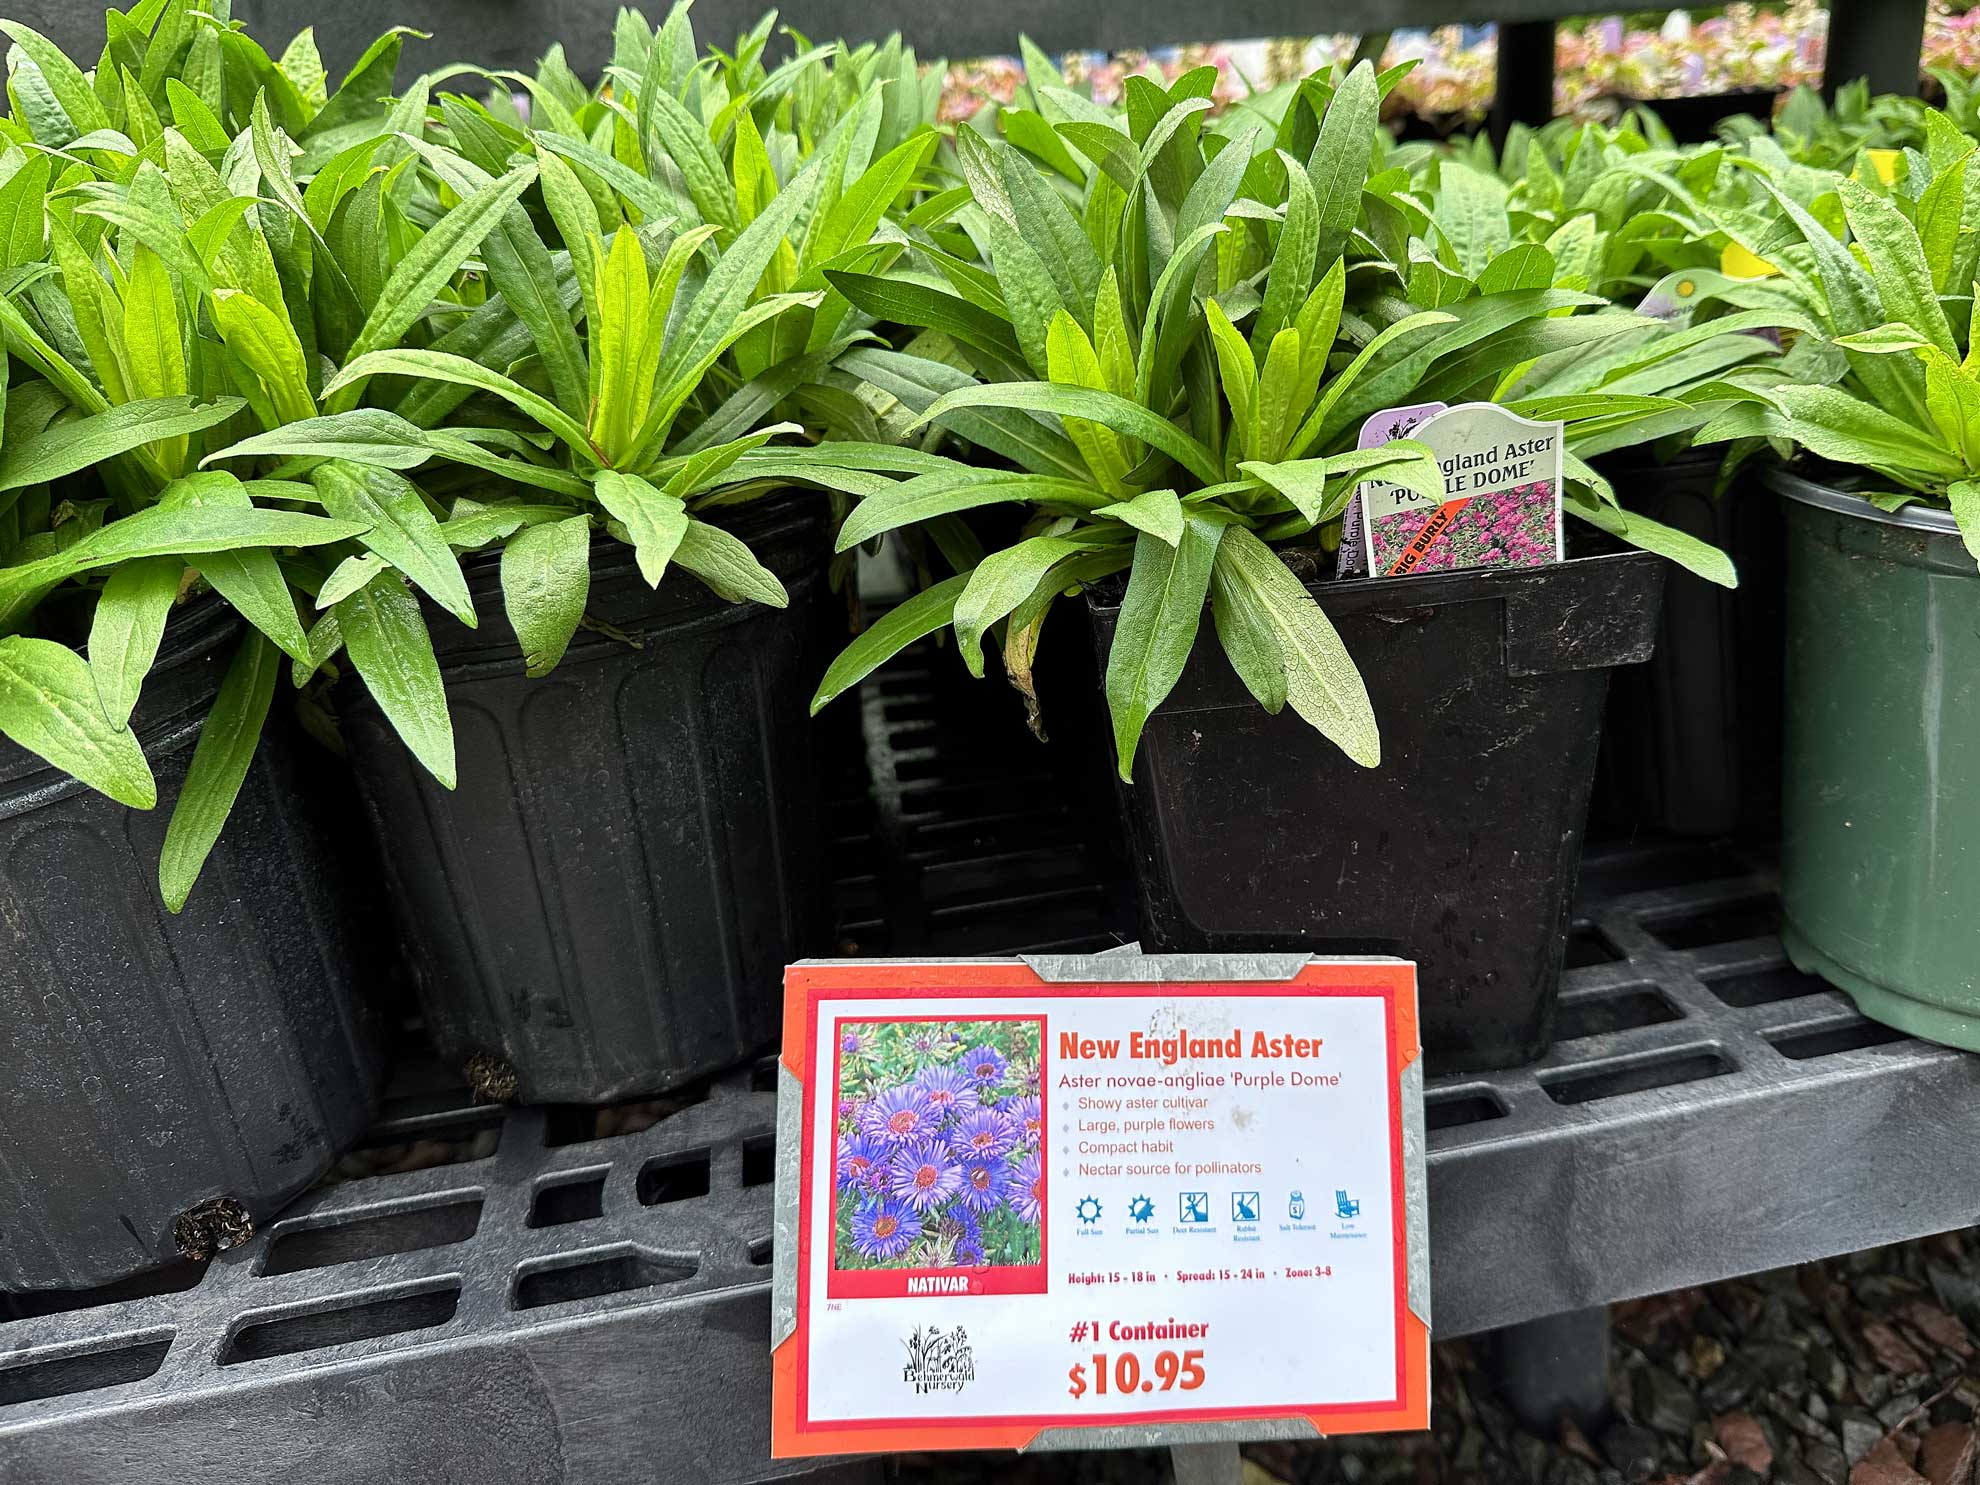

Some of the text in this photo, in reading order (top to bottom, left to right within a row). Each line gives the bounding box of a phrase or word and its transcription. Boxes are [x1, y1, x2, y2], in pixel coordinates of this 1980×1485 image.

[1504, 437, 1554, 461] Aster
[1394, 553, 1417, 574] BIG
[1060, 1028, 1323, 1065] New England Aster
[1058, 1071, 1342, 1091] Aster novae-angliae 'Purple Dome'
[1078, 1096, 1208, 1112] Showy aster cultivar
[1078, 1118, 1214, 1134] Large, purple flowers
[1078, 1139, 1174, 1156] Compact habit
[1078, 1161, 1262, 1177] Nectar source for pollinators
[907, 1276, 969, 1294] NATIVAR
[1068, 1271, 1105, 1285] Height:
[1108, 1271, 1120, 1283] 15
[1131, 1271, 1143, 1282] 18
[1146, 1271, 1156, 1282] in
[1176, 1269, 1215, 1283] Spread:
[1219, 1269, 1230, 1280] 15
[1240, 1268, 1253, 1280] 24
[1255, 1268, 1265, 1279] in
[1285, 1267, 1313, 1278] Zone:
[1315, 1266, 1332, 1277] 3-8
[1069, 1316, 1209, 1343] #1 Container
[1068, 1349, 1206, 1400] $10.95
[915, 1380, 965, 1395] Nursery
